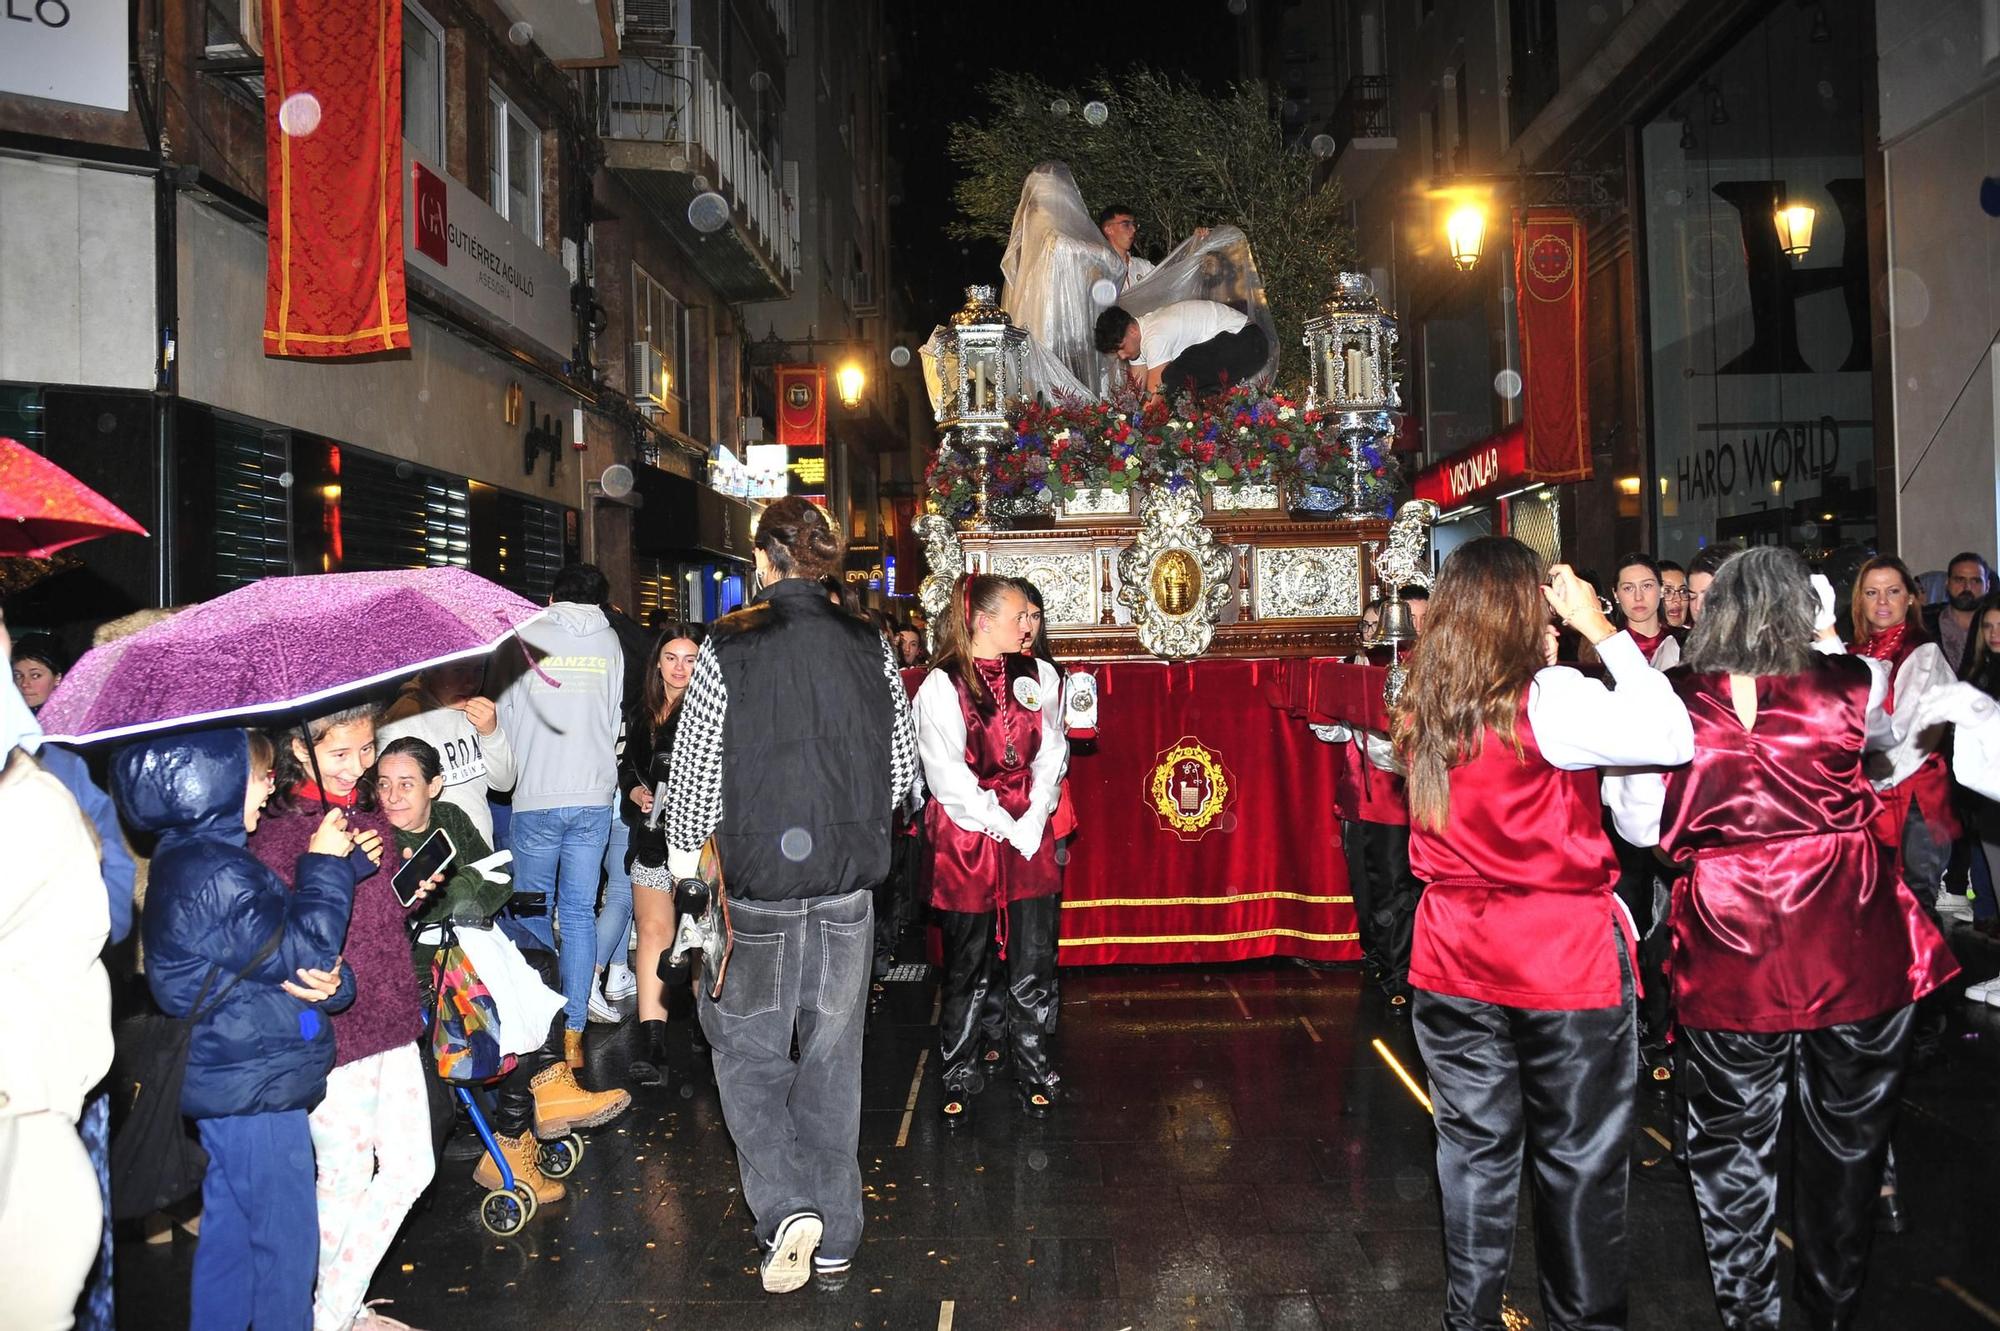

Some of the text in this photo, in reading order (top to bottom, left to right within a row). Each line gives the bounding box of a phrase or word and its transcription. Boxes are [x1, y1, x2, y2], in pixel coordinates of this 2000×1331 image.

[447, 223, 534, 298] GUTIÉRREZ AGULLÓ
[1449, 447, 1498, 499] VISIONLAB
[1677, 415, 1839, 503] HARO WORLD
[541, 656, 607, 668] WANZIG
